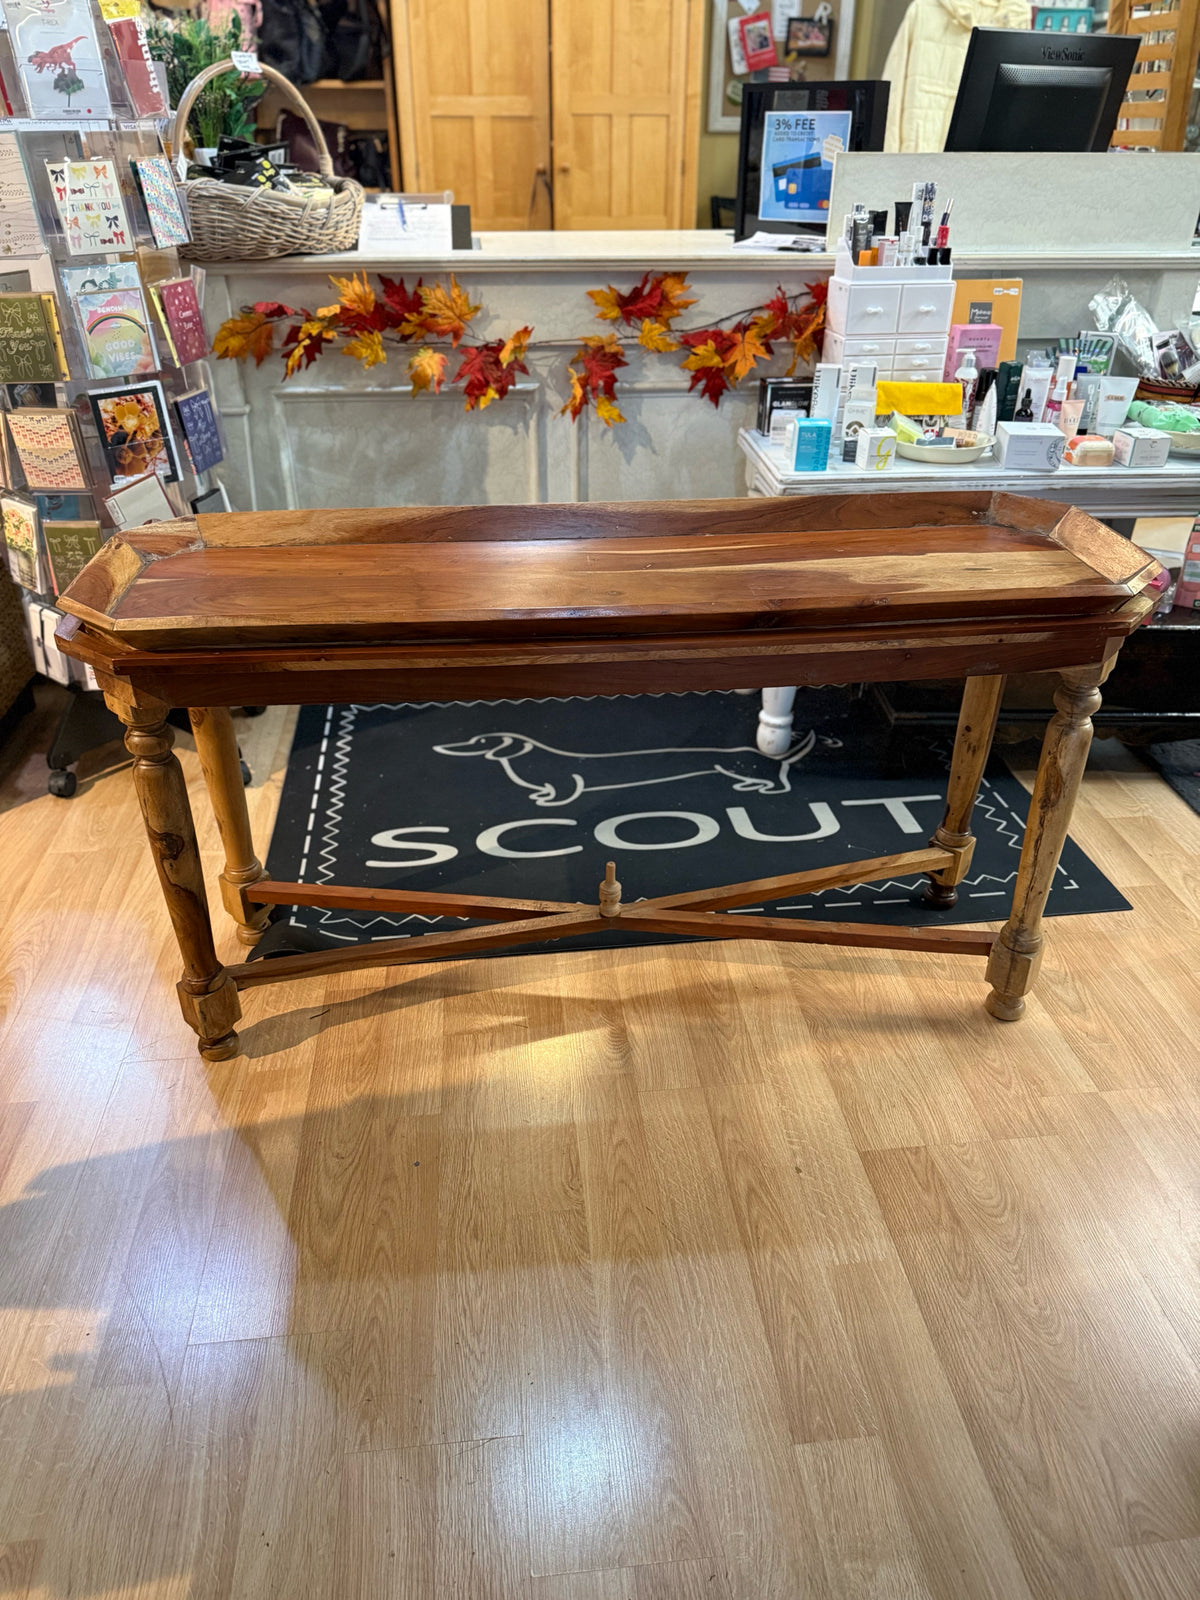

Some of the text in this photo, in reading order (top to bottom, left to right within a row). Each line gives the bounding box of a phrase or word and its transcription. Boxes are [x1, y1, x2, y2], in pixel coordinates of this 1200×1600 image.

[1041, 46, 1085, 61] ViewSonic
[775, 118, 816, 130] 3% FEE
[71, 201, 111, 212] THANK YOU
[105, 340, 135, 352] GOOD
[107, 351, 136, 363] VIBES
[365, 795, 943, 869] SCOUT
